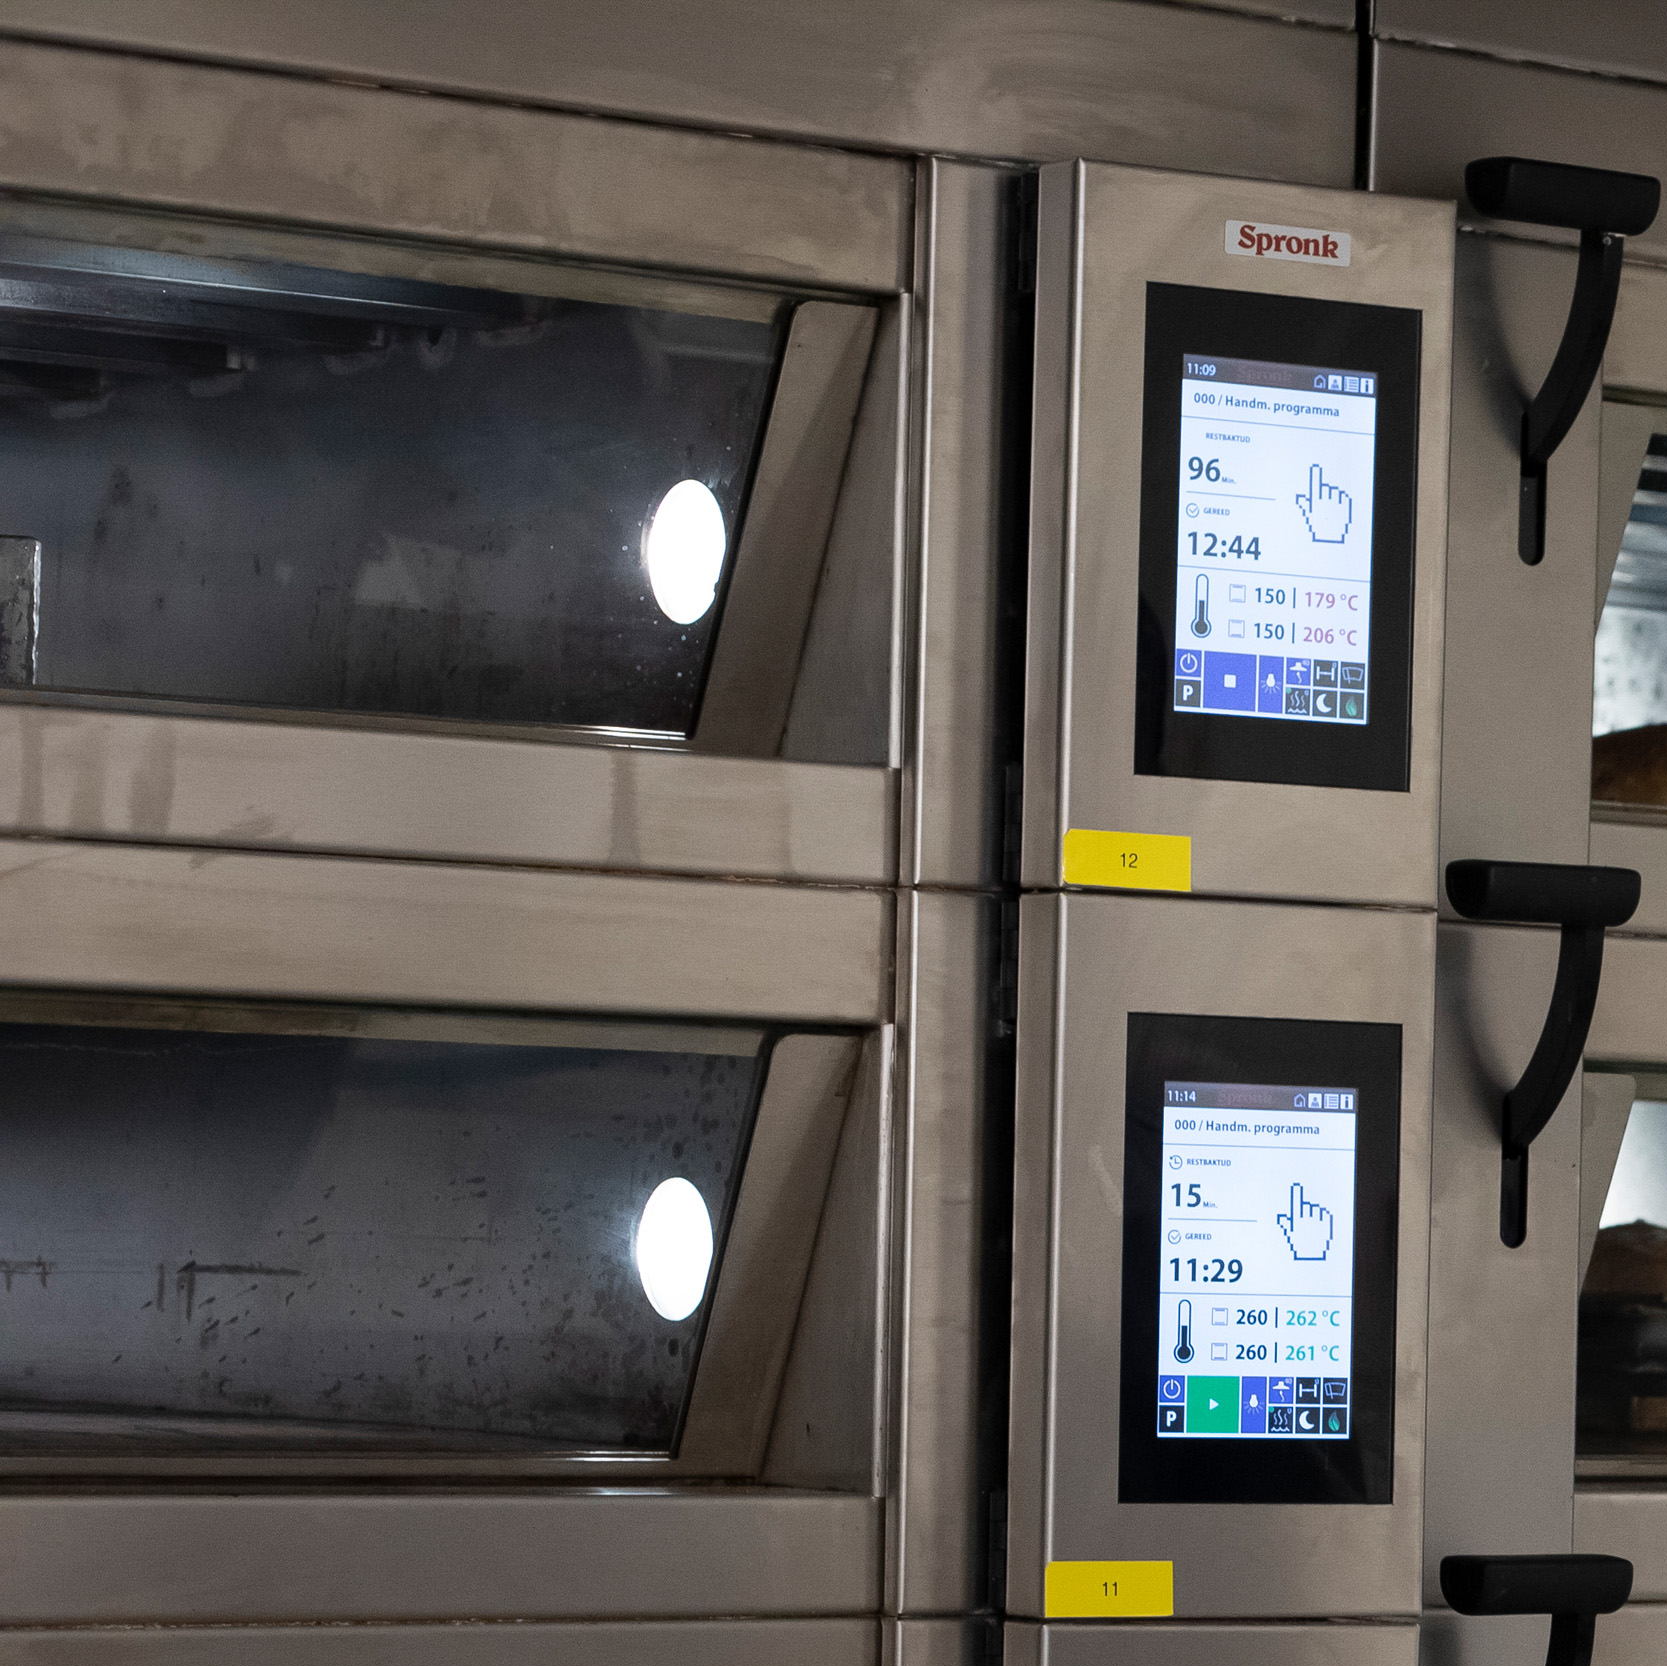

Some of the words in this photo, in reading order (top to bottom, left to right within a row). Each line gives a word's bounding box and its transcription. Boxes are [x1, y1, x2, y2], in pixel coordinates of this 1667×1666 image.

[1238, 224, 1339, 259] Spronk
[1188, 363, 1216, 376] 11:09
[1194, 392, 1215, 405] 000
[1226, 395, 1270, 410] Handm.
[1274, 403, 1339, 417] programma
[1188, 457, 1220, 482] 96
[1203, 507, 1230, 516] GEREED
[1188, 531, 1261, 560] 12:44
[1255, 588, 1285, 605] 150
[1305, 592, 1335, 609] 179
[1340, 594, 1358, 611] °C
[1254, 623, 1284, 640] 150
[1303, 626, 1334, 644] 206
[1339, 629, 1357, 646] °C
[1183, 685, 1193, 701] P
[1120, 852, 1139, 868] 12
[1168, 1090, 1196, 1102] 11:14
[1175, 1119, 1196, 1130] 000
[1206, 1120, 1251, 1132] Handm.
[1254, 1125, 1319, 1136] programma
[1171, 1183, 1201, 1207] 15
[1170, 1258, 1243, 1283] 11:29
[1236, 1309, 1267, 1325] 260
[1286, 1310, 1317, 1326] 262
[1322, 1310, 1340, 1327] °C
[1236, 1344, 1267, 1360] 260
[1285, 1345, 1314, 1361] 261
[1321, 1345, 1339, 1361] °C
[1166, 1411, 1177, 1427] P
[1102, 1582, 1118, 1596] 11
